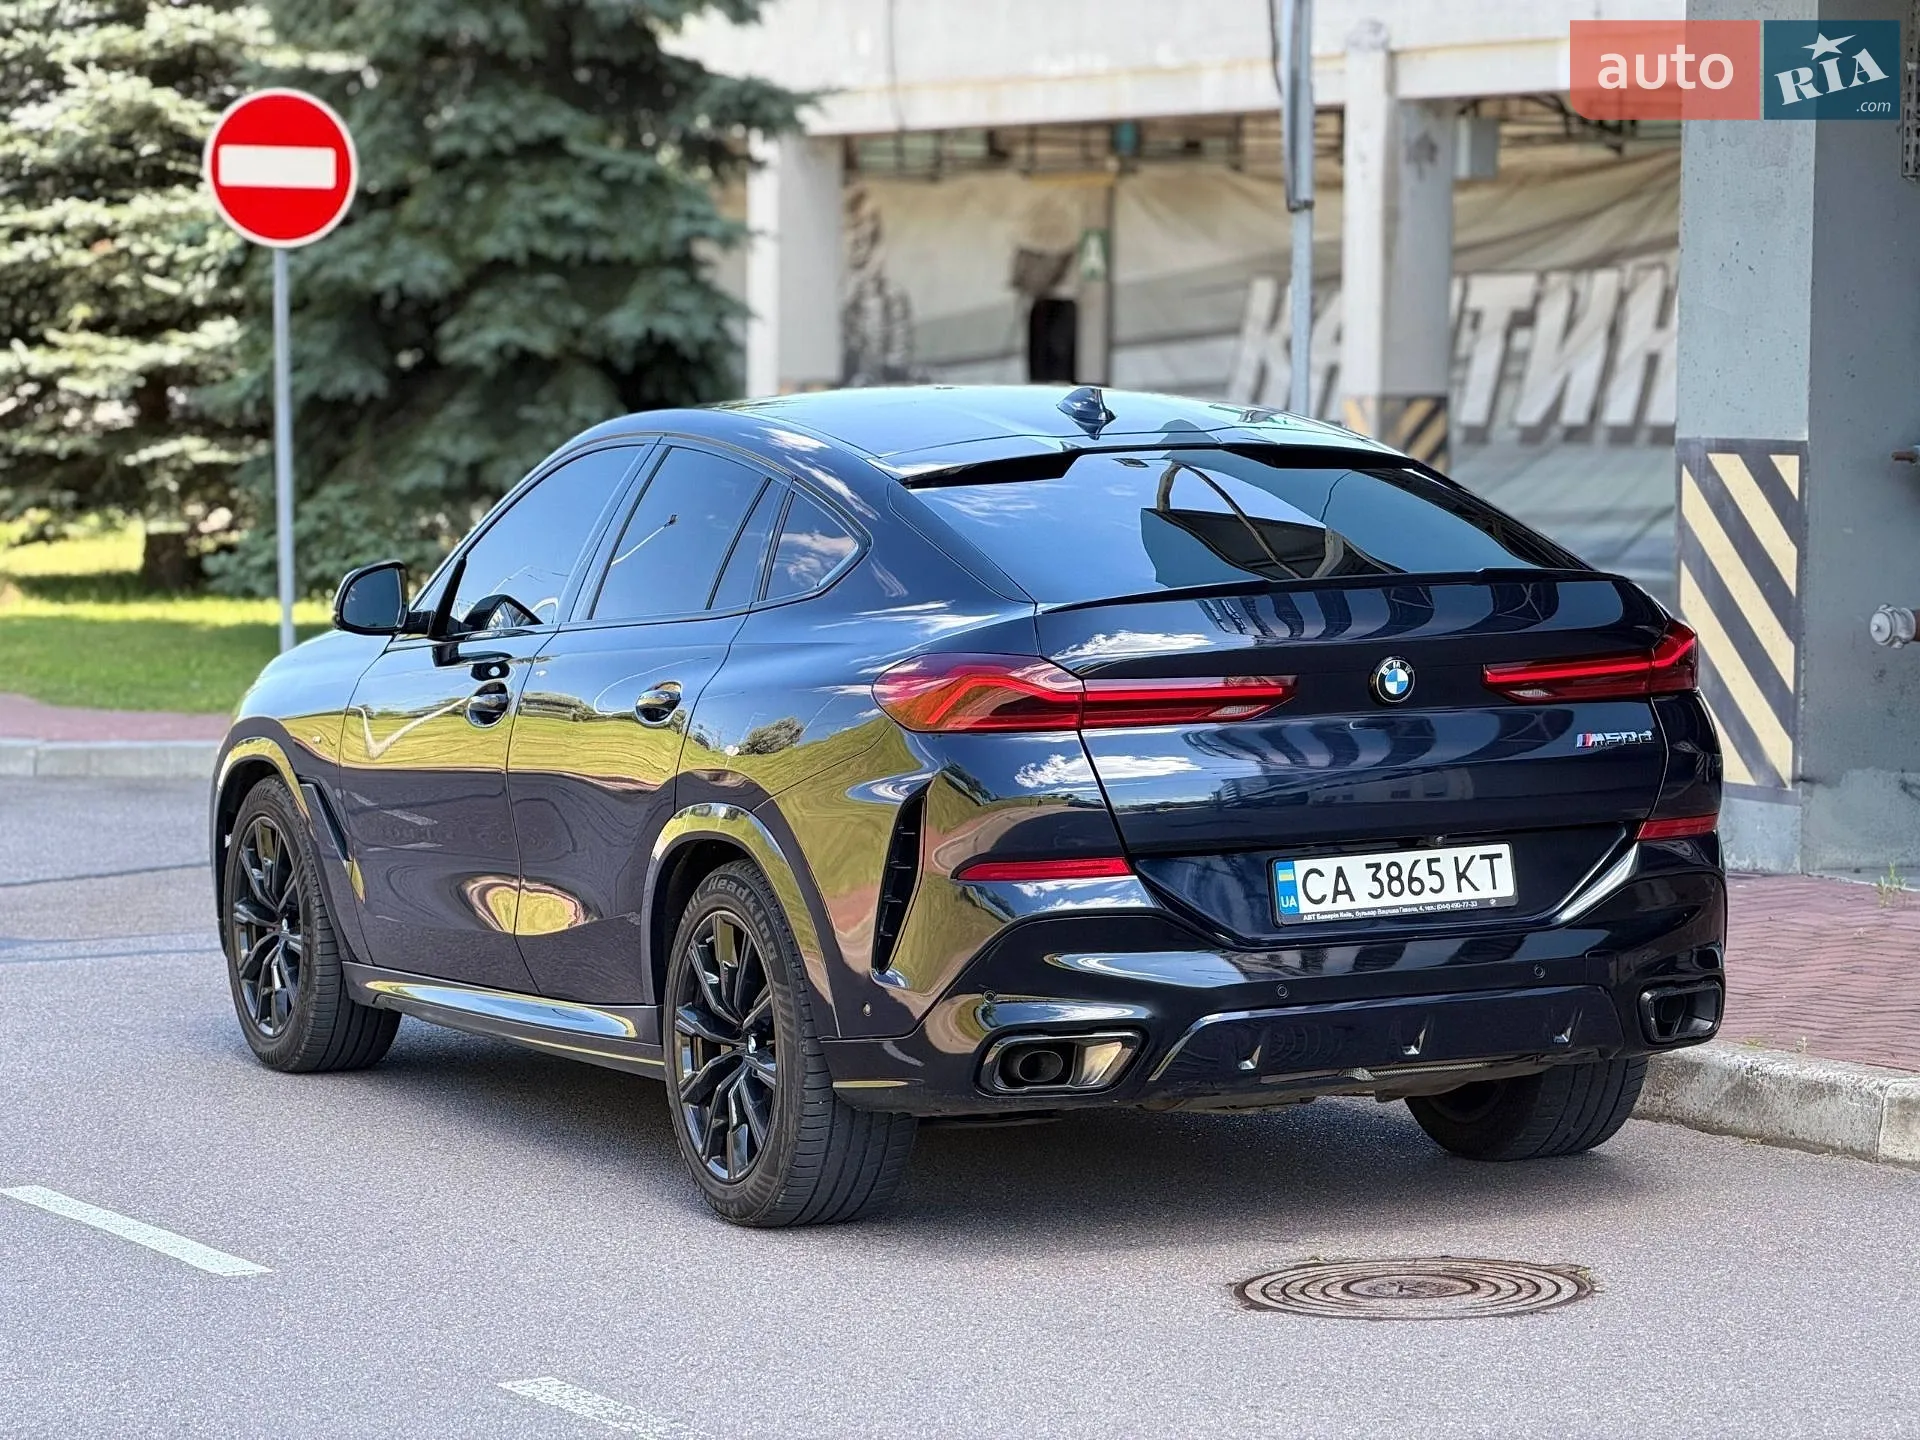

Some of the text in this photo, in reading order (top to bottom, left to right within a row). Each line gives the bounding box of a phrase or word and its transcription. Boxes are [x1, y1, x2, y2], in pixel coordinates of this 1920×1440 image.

[1381, 661, 1411, 675] BMW
[1302, 852, 1503, 905] CA 3865 KT
[1280, 895, 1298, 908] UA
